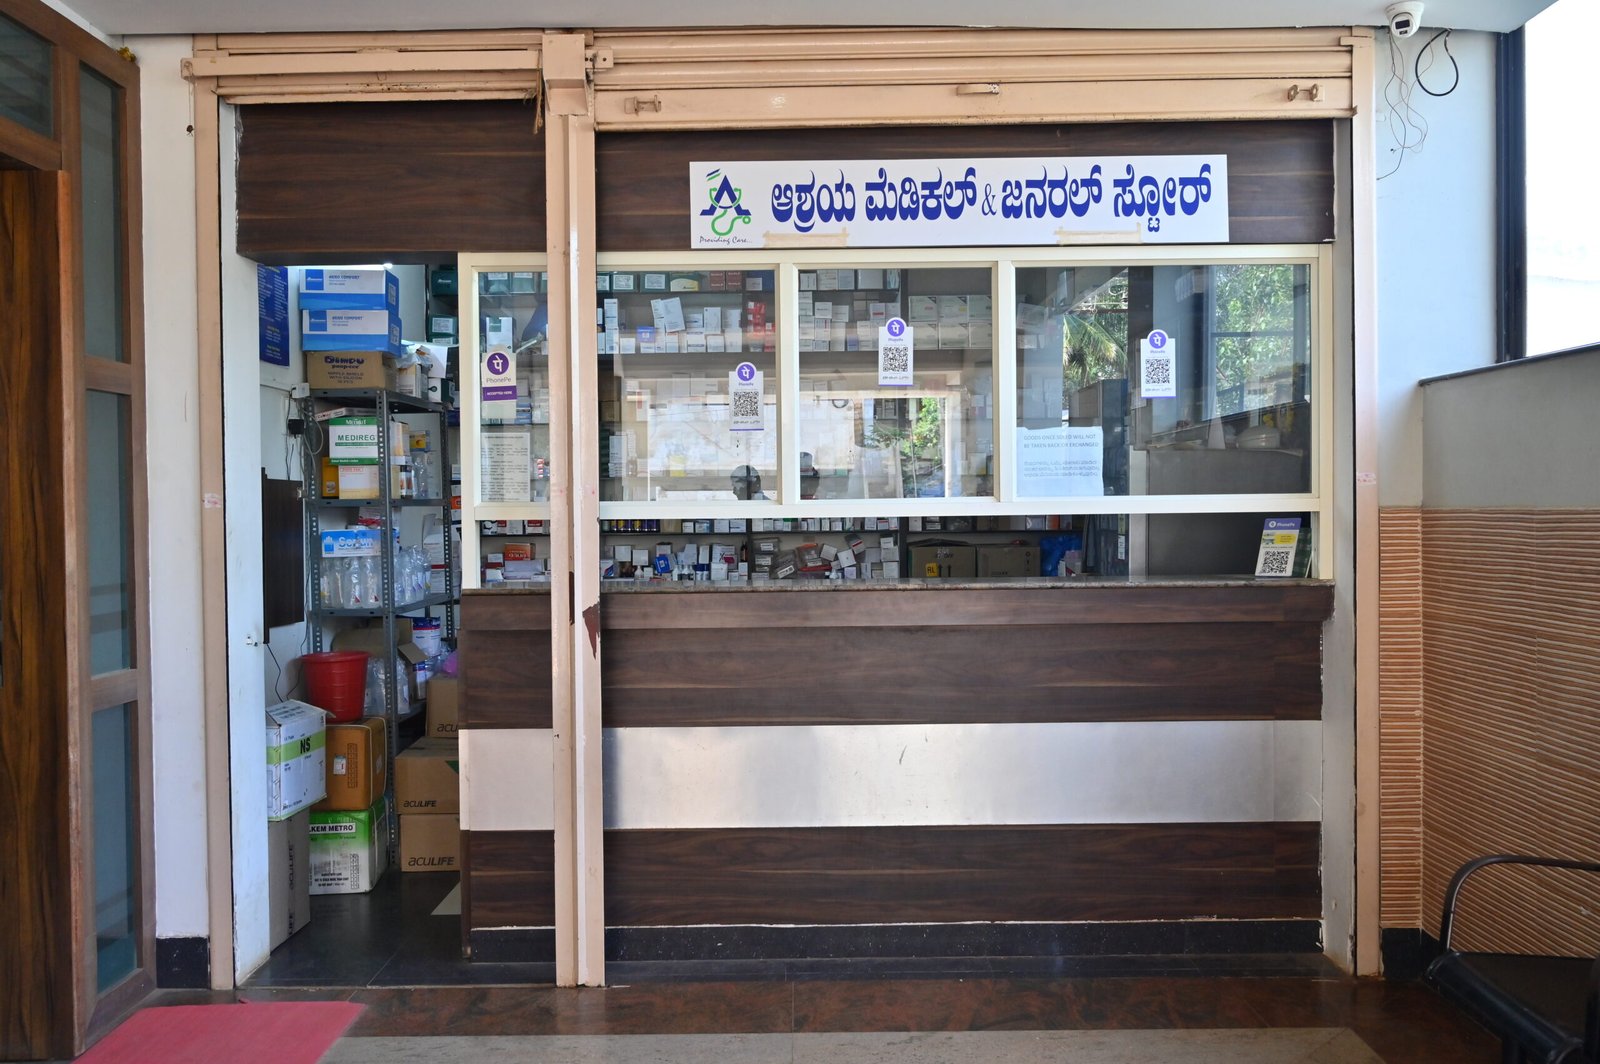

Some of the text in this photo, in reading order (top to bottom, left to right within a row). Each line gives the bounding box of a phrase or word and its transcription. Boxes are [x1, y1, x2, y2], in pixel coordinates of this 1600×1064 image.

[771, 163, 1212, 233] ಆಶ್ರಯ ಮೆಡಿಕಲ್ & ಜನರಲ್ ಸ್ಟೋರ್
[699, 235, 731, 245] Providing
[337, 434, 376, 442] MEDIREG
[300, 736, 312, 755] NS
[328, 824, 354, 832] METRO
